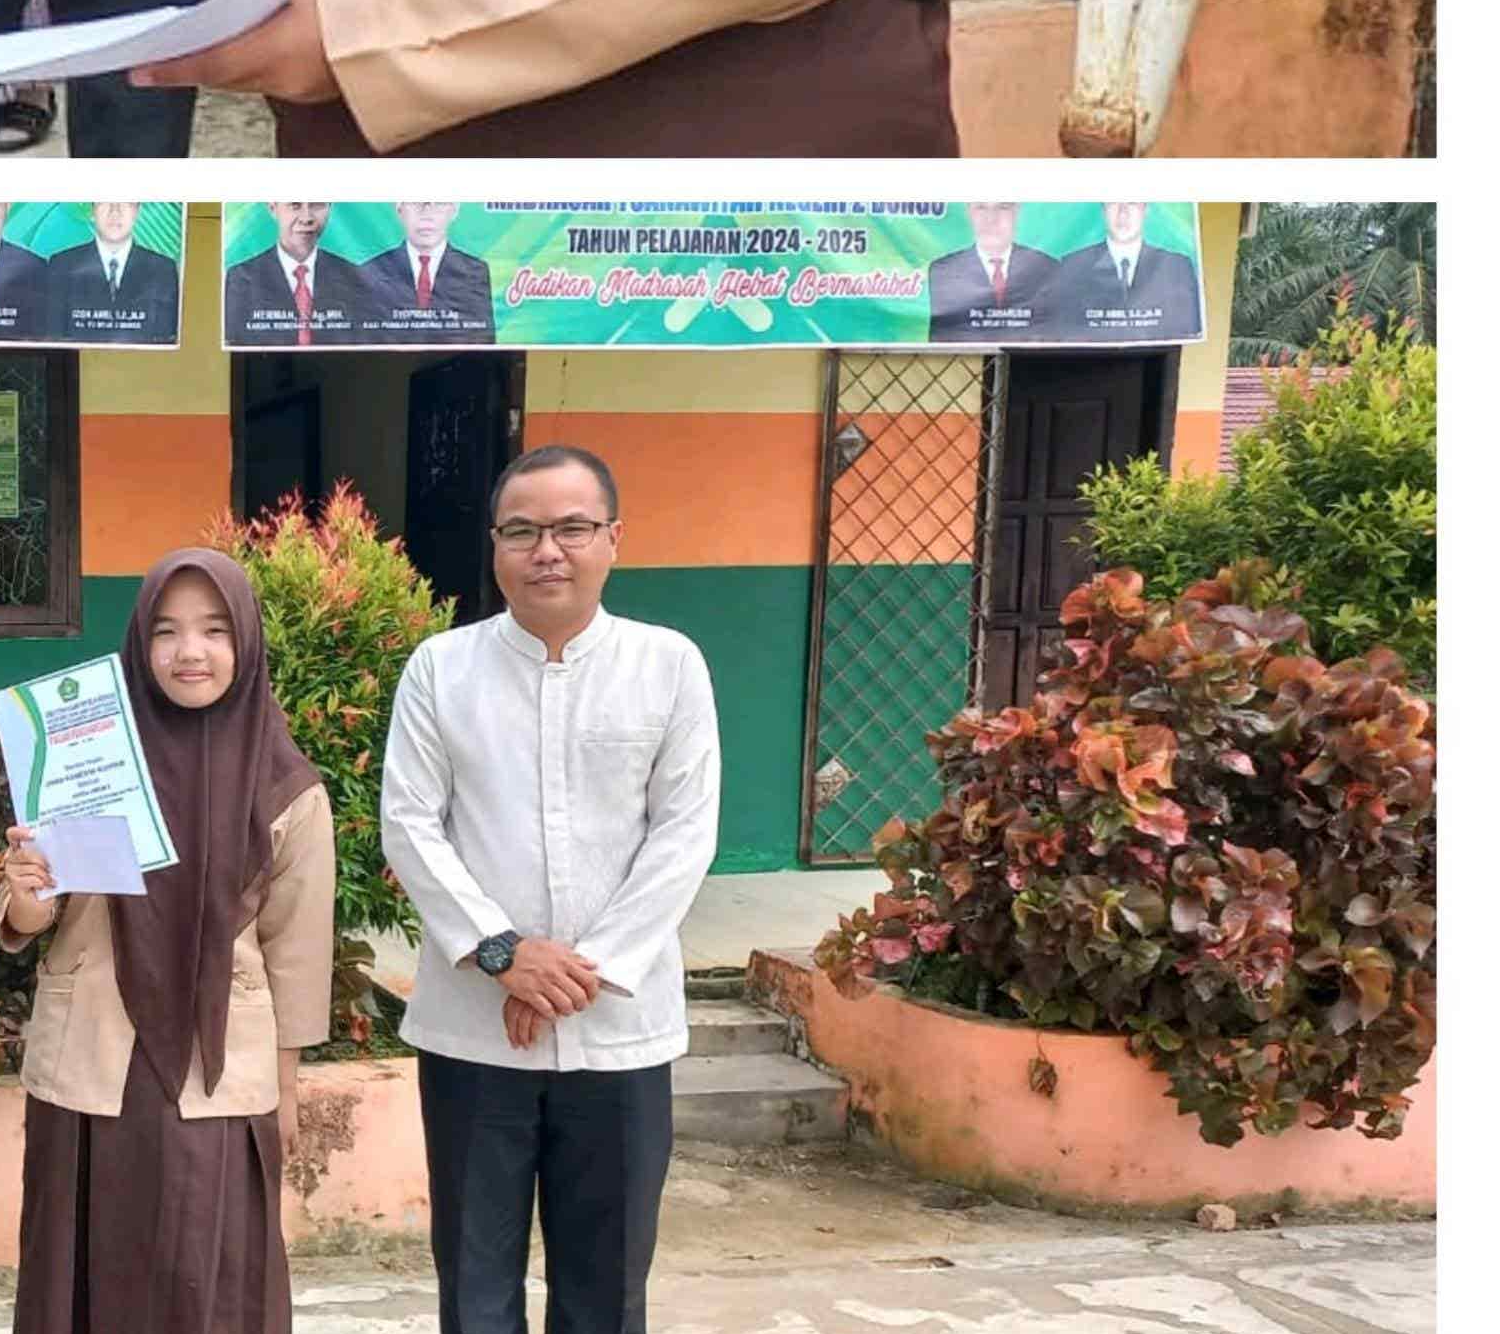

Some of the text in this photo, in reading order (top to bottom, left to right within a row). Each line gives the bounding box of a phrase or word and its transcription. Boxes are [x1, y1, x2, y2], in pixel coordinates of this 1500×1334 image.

[568, 228, 630, 254] TAHUN
[635, 226, 745, 254] PELAJARAN
[744, 228, 801, 254] 2024
[817, 227, 866, 253] 2025
[508, 267, 921, 306] Jadikan Madrasah Hebat Bermartabat
